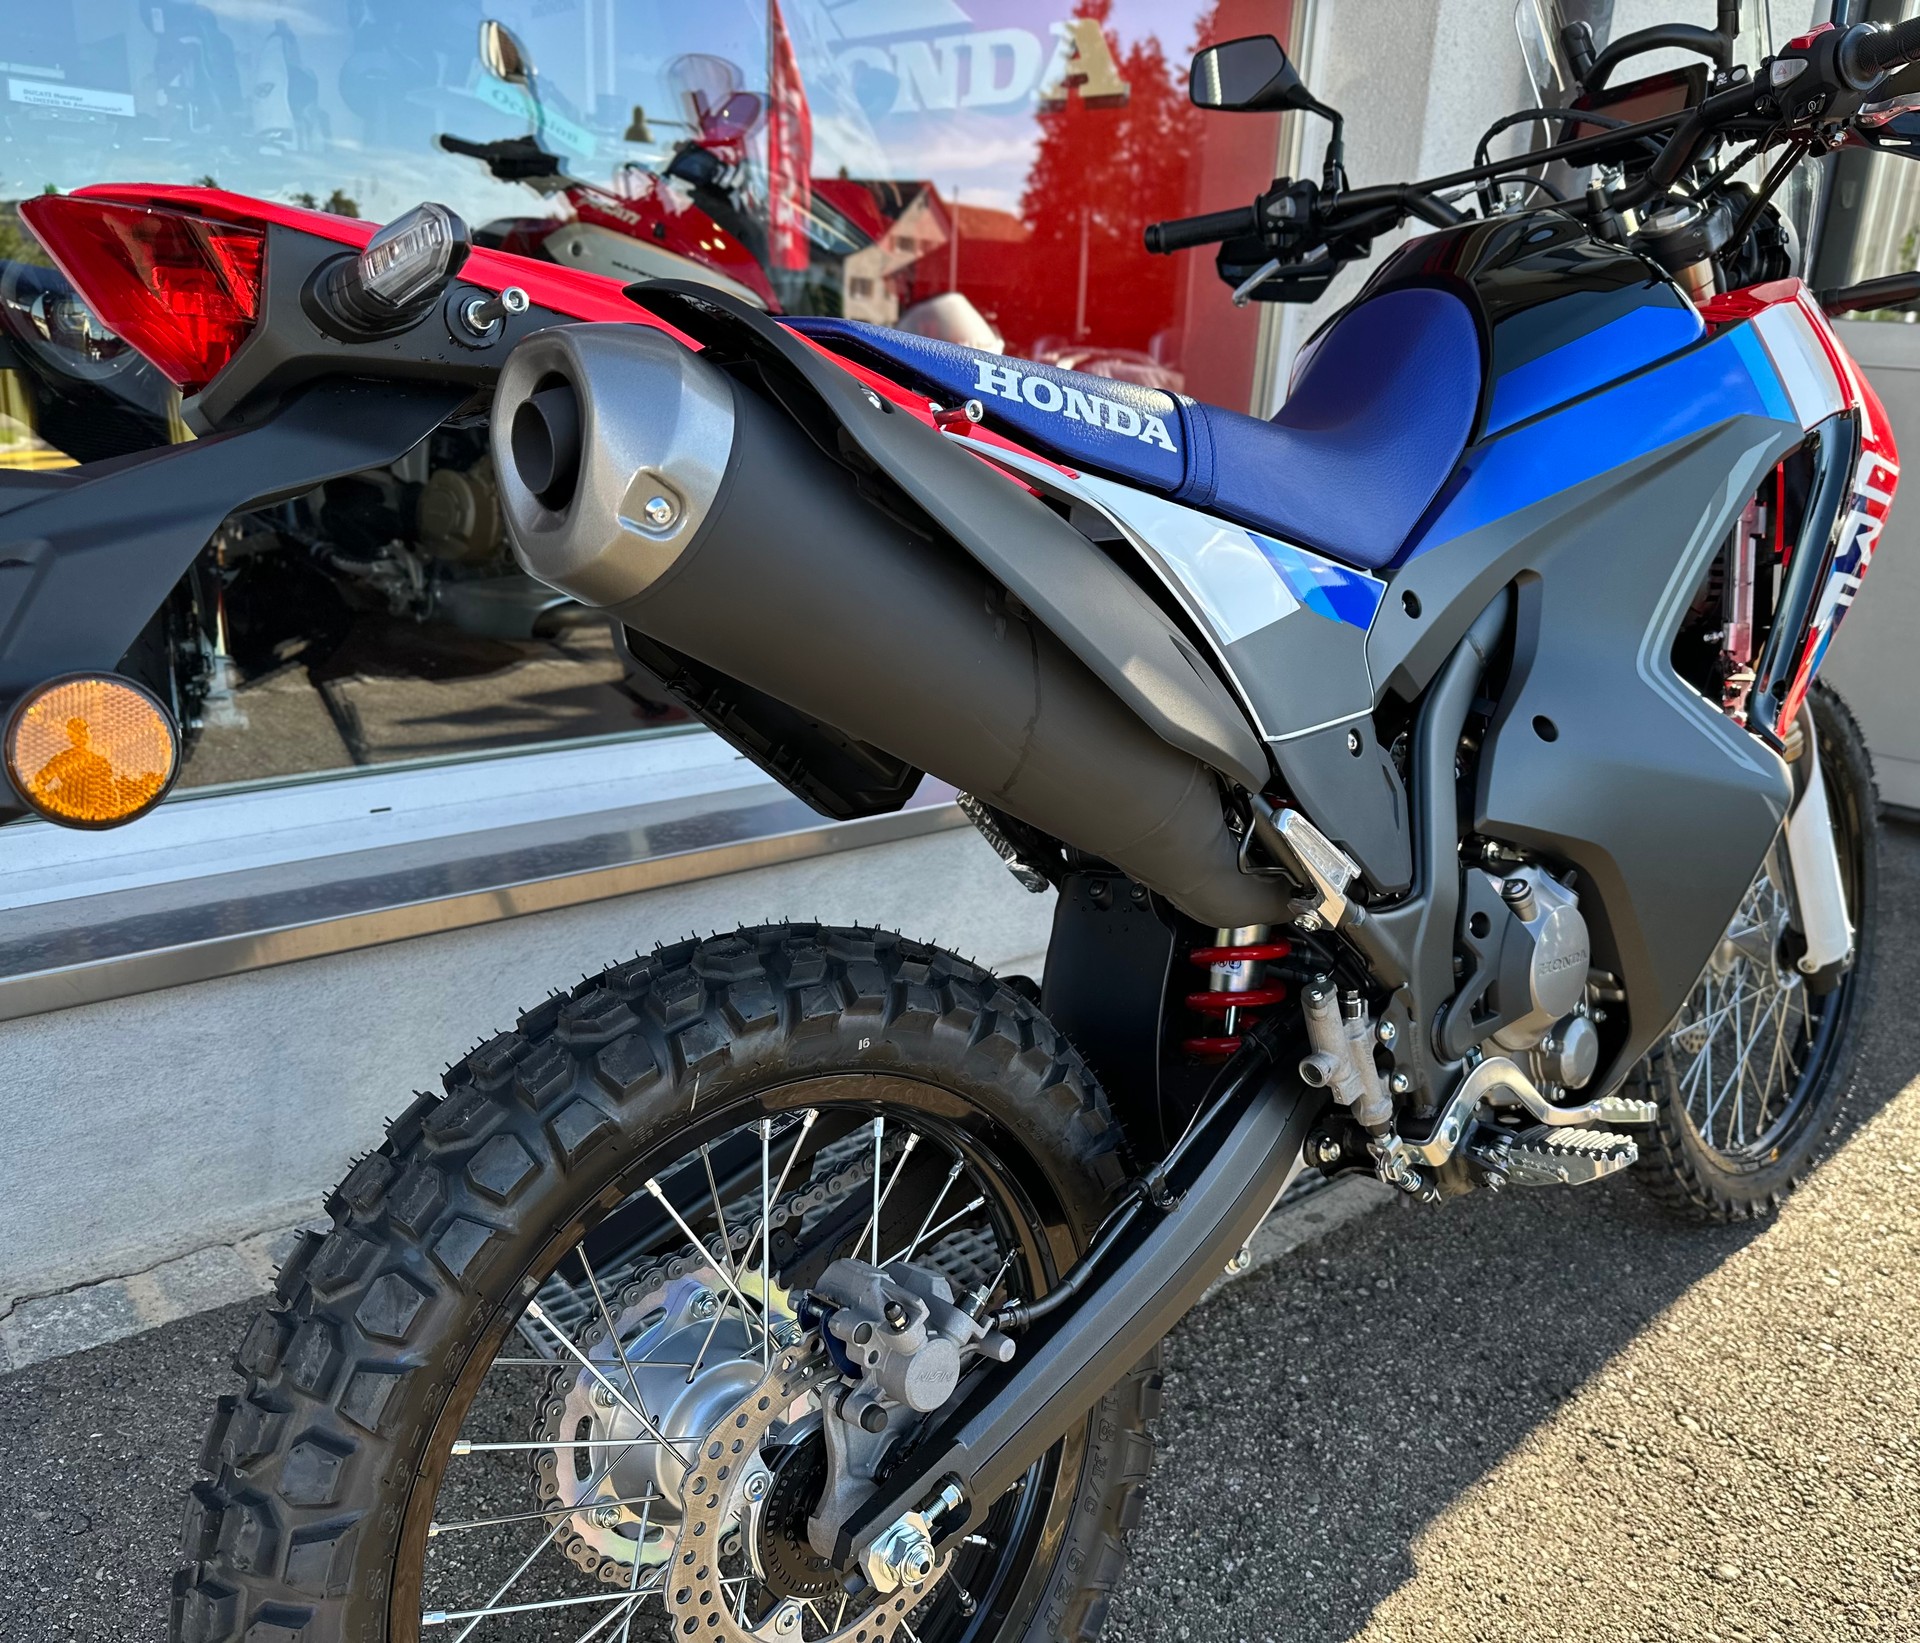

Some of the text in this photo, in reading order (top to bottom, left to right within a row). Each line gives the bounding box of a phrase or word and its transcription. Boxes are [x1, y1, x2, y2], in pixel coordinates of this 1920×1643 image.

[838, 18, 1128, 112] ONDA
[973, 358, 1178, 454] HONDA
[1538, 949, 1588, 977] HONDA
[858, 1037, 871, 1050] 16
